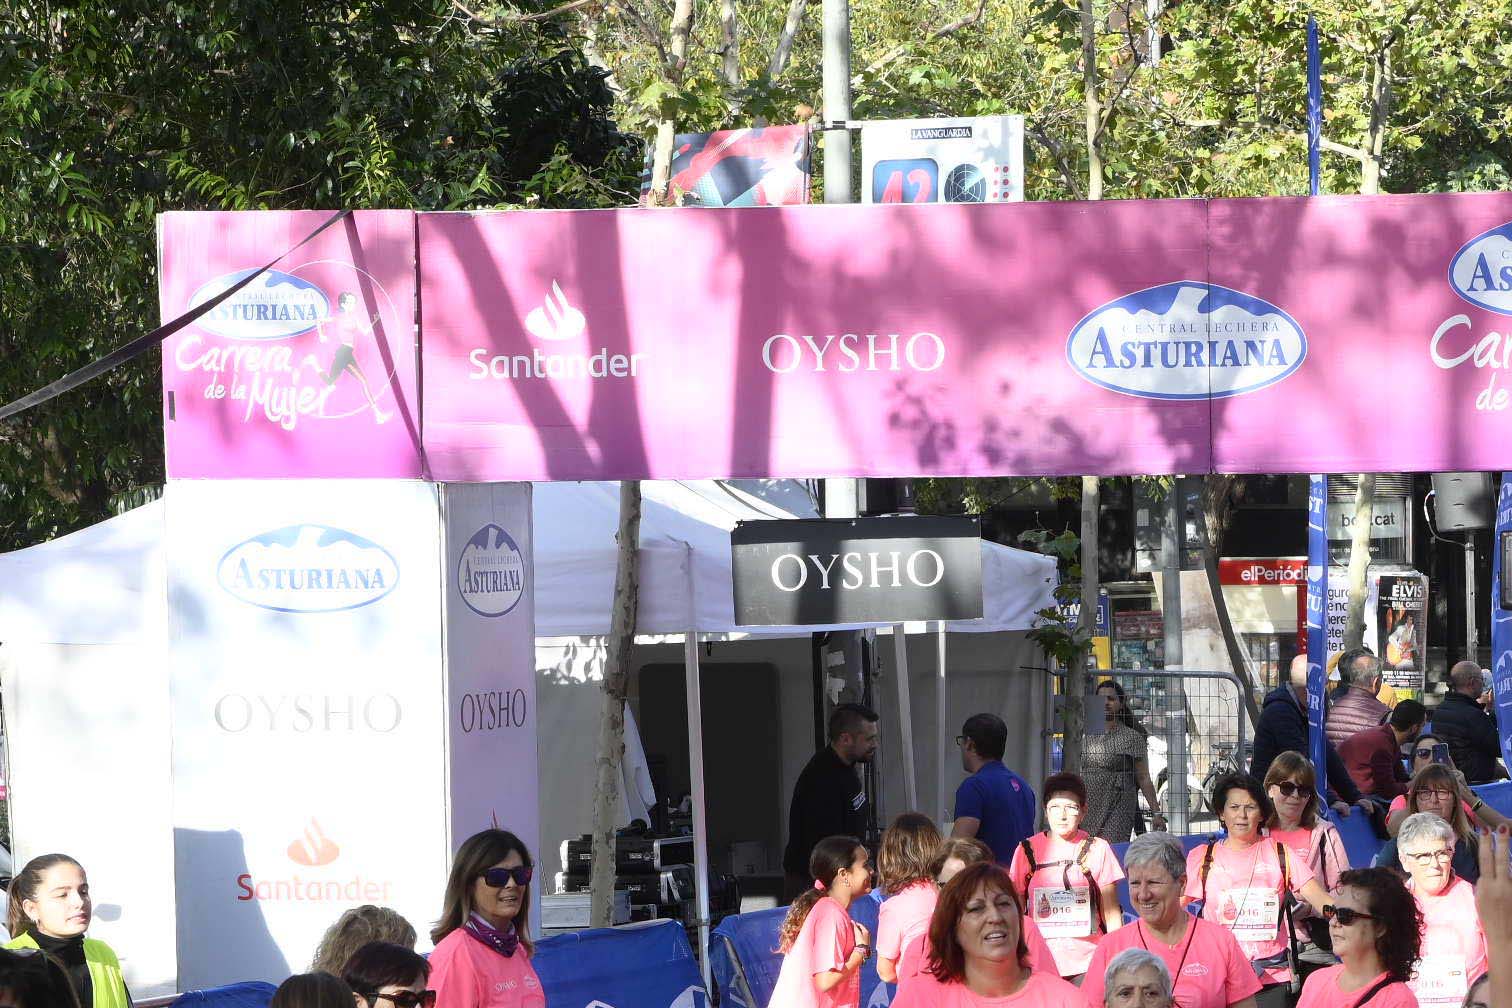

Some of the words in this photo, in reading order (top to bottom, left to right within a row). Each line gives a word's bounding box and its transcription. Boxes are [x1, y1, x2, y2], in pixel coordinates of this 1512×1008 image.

[1122, 322, 1197, 334] CENTRAL
[1204, 320, 1280, 333] LECHERA
[175, 335, 293, 372] Carrera
[468, 347, 649, 379] Santander
[761, 332, 946, 374] OYSHO
[1086, 326, 1288, 369] ASTURIANA
[204, 374, 226, 399] de
[231, 373, 247, 399] la
[245, 371, 337, 430] Mujer
[1475, 372, 1508, 411] de
[233, 557, 386, 591] ASTURIANA
[463, 559, 521, 595] ASTURIANA
[771, 549, 945, 592] OYSHO
[1392, 585, 1423, 597] ELVIS
[214, 692, 402, 734] OYSHO
[460, 688, 527, 734] OYSHO
[236, 872, 391, 901] Santander
[1052, 906, 1072, 914] 016
